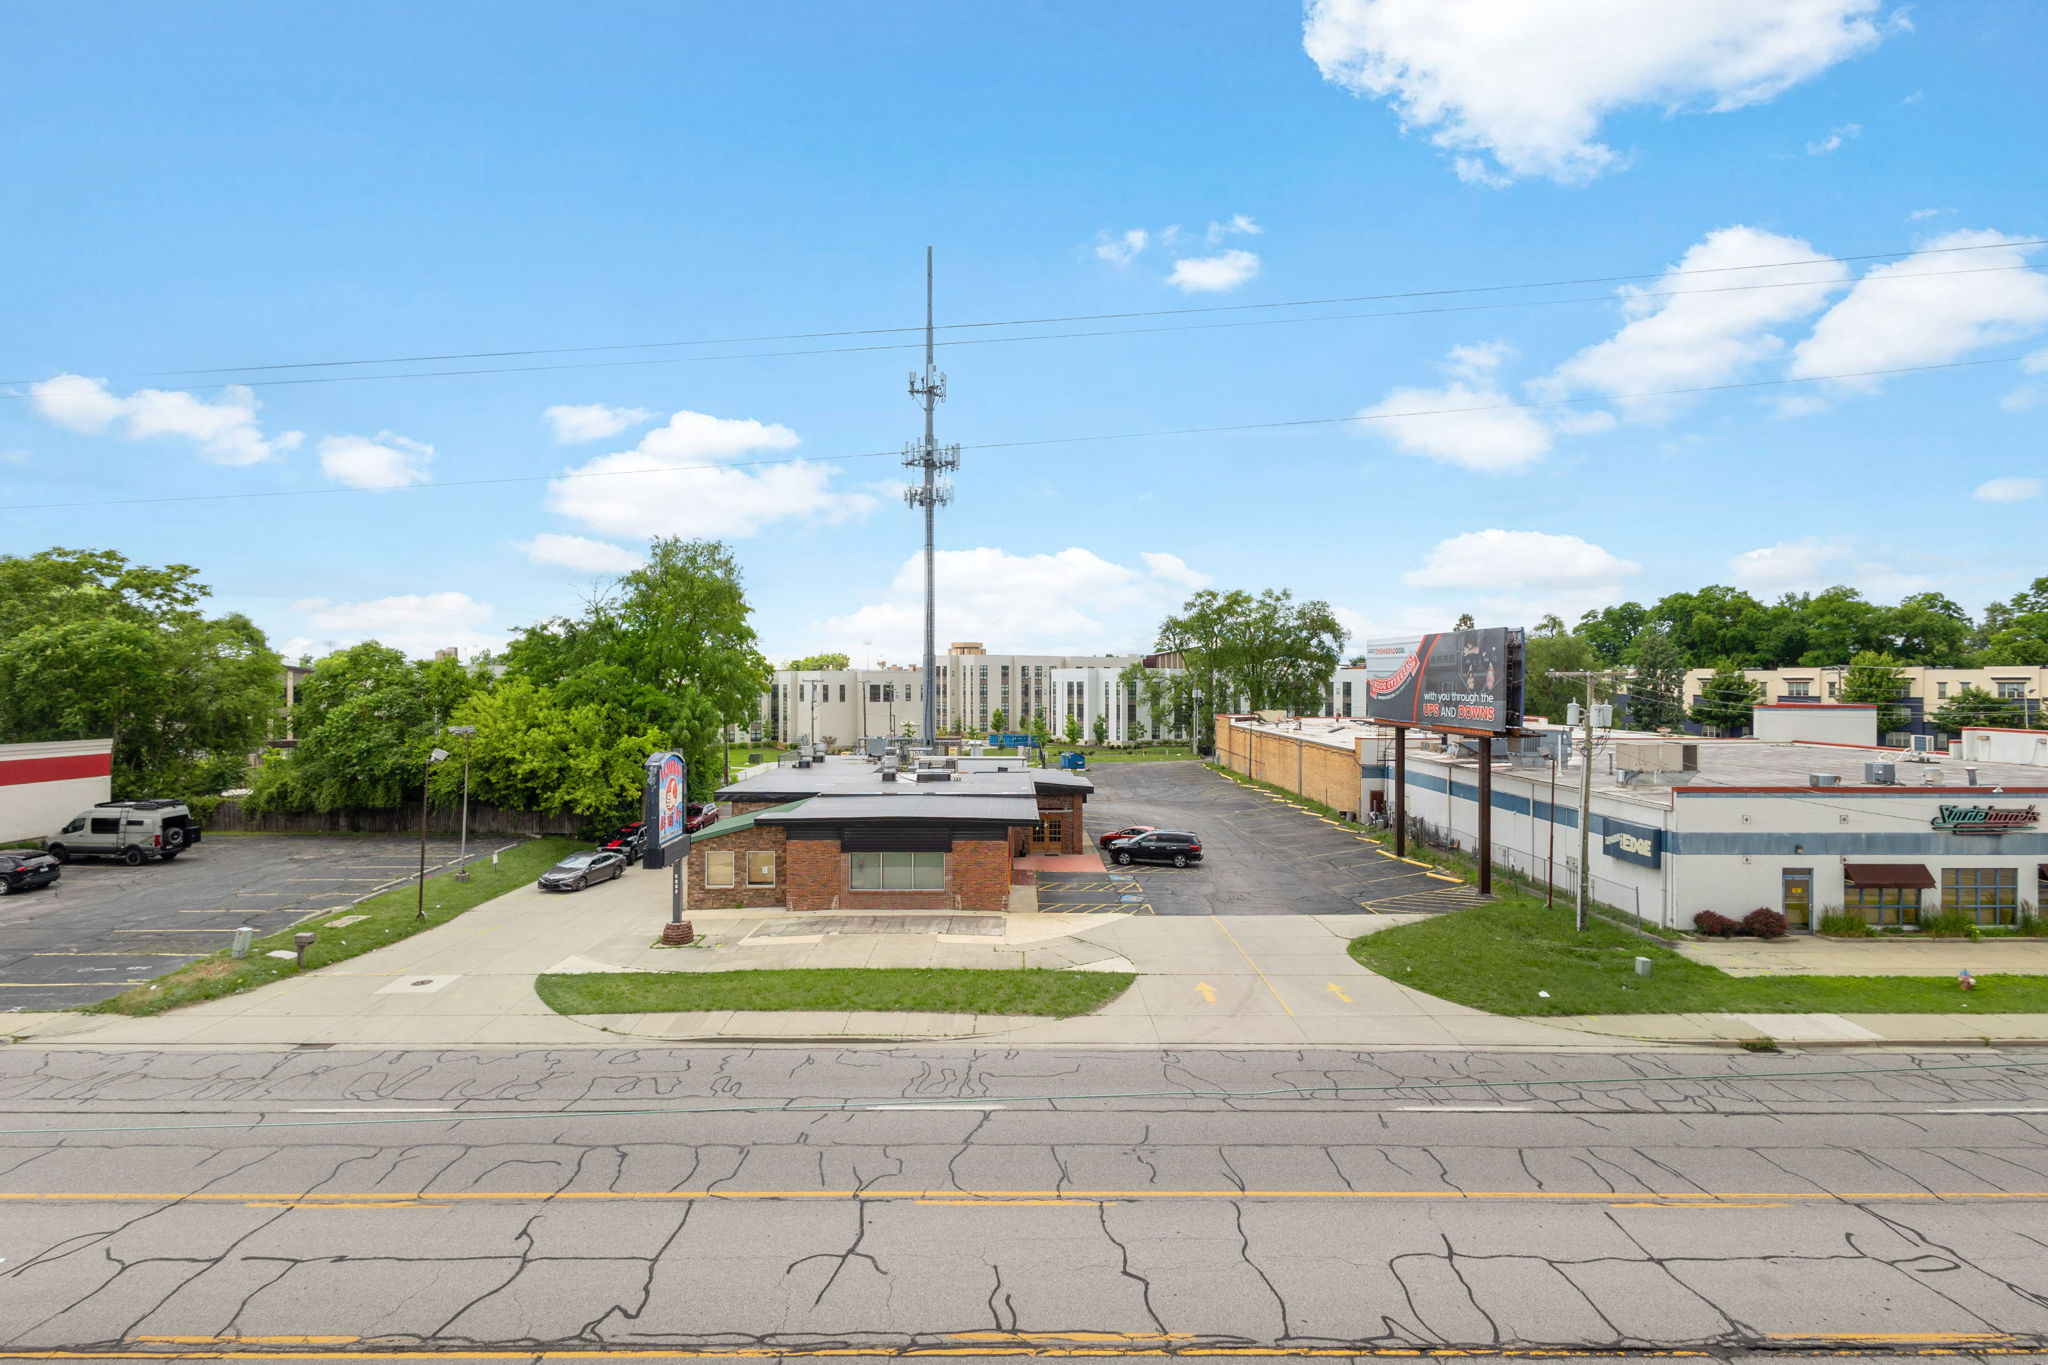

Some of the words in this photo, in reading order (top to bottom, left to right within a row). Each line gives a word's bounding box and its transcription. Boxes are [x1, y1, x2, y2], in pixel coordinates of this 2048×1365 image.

[1423, 691, 1437, 701] with
[1438, 693, 1450, 702] you
[1451, 692, 1479, 704] through
[1481, 692, 1494, 702] the
[1423, 703, 1439, 717] UPS
[1441, 706, 1457, 717] AND
[1457, 705, 1495, 721] DOWNS
[1622, 833, 1652, 857] EDGE
